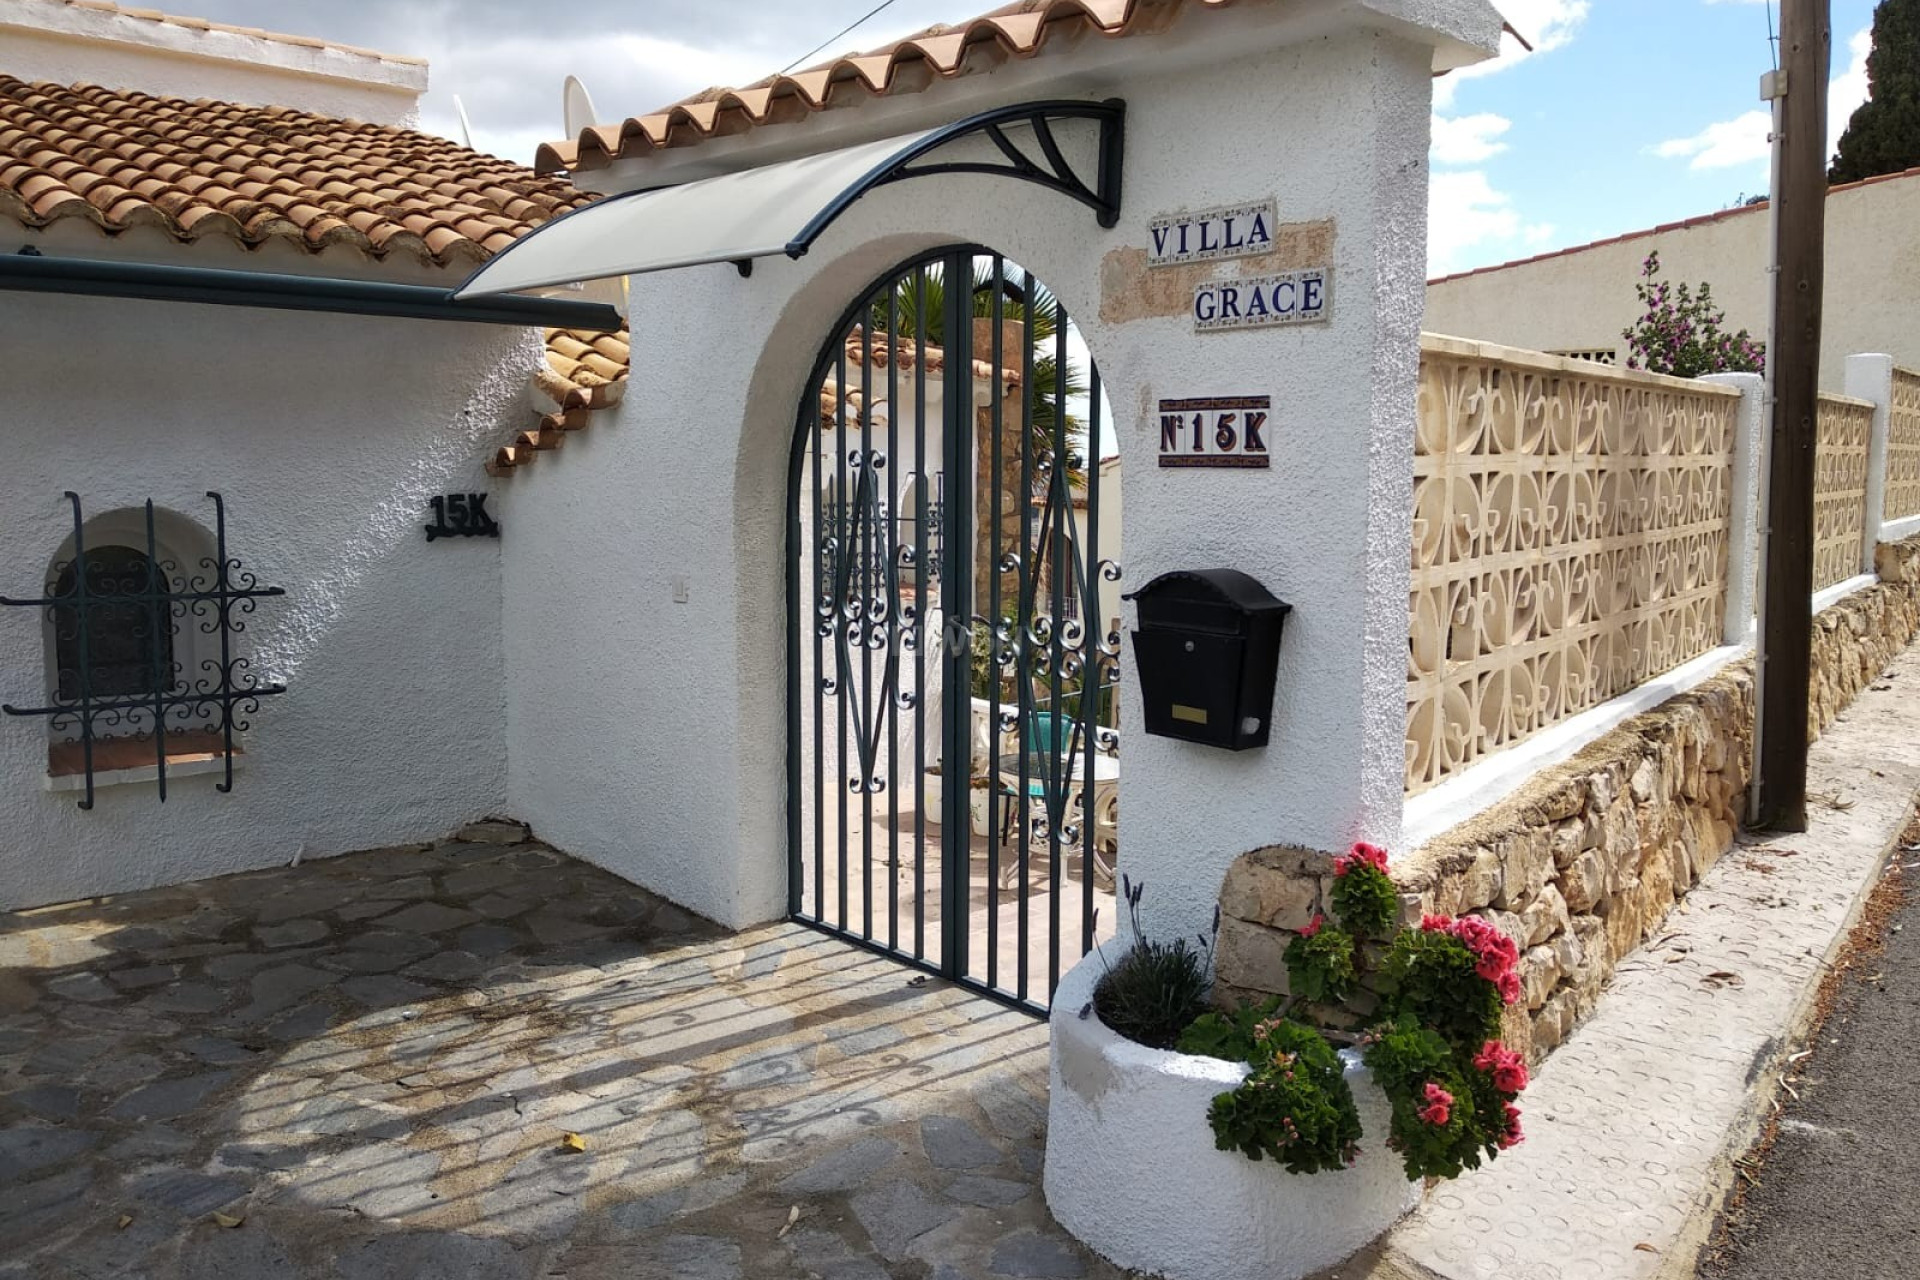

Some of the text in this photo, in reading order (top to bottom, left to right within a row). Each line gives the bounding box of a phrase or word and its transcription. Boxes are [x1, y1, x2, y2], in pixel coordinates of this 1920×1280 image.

[1151, 213, 1270, 257] VILLA
[1195, 278, 1323, 321] GRACE
[1192, 412, 1267, 452] 15K
[430, 492, 498, 531] 15K
